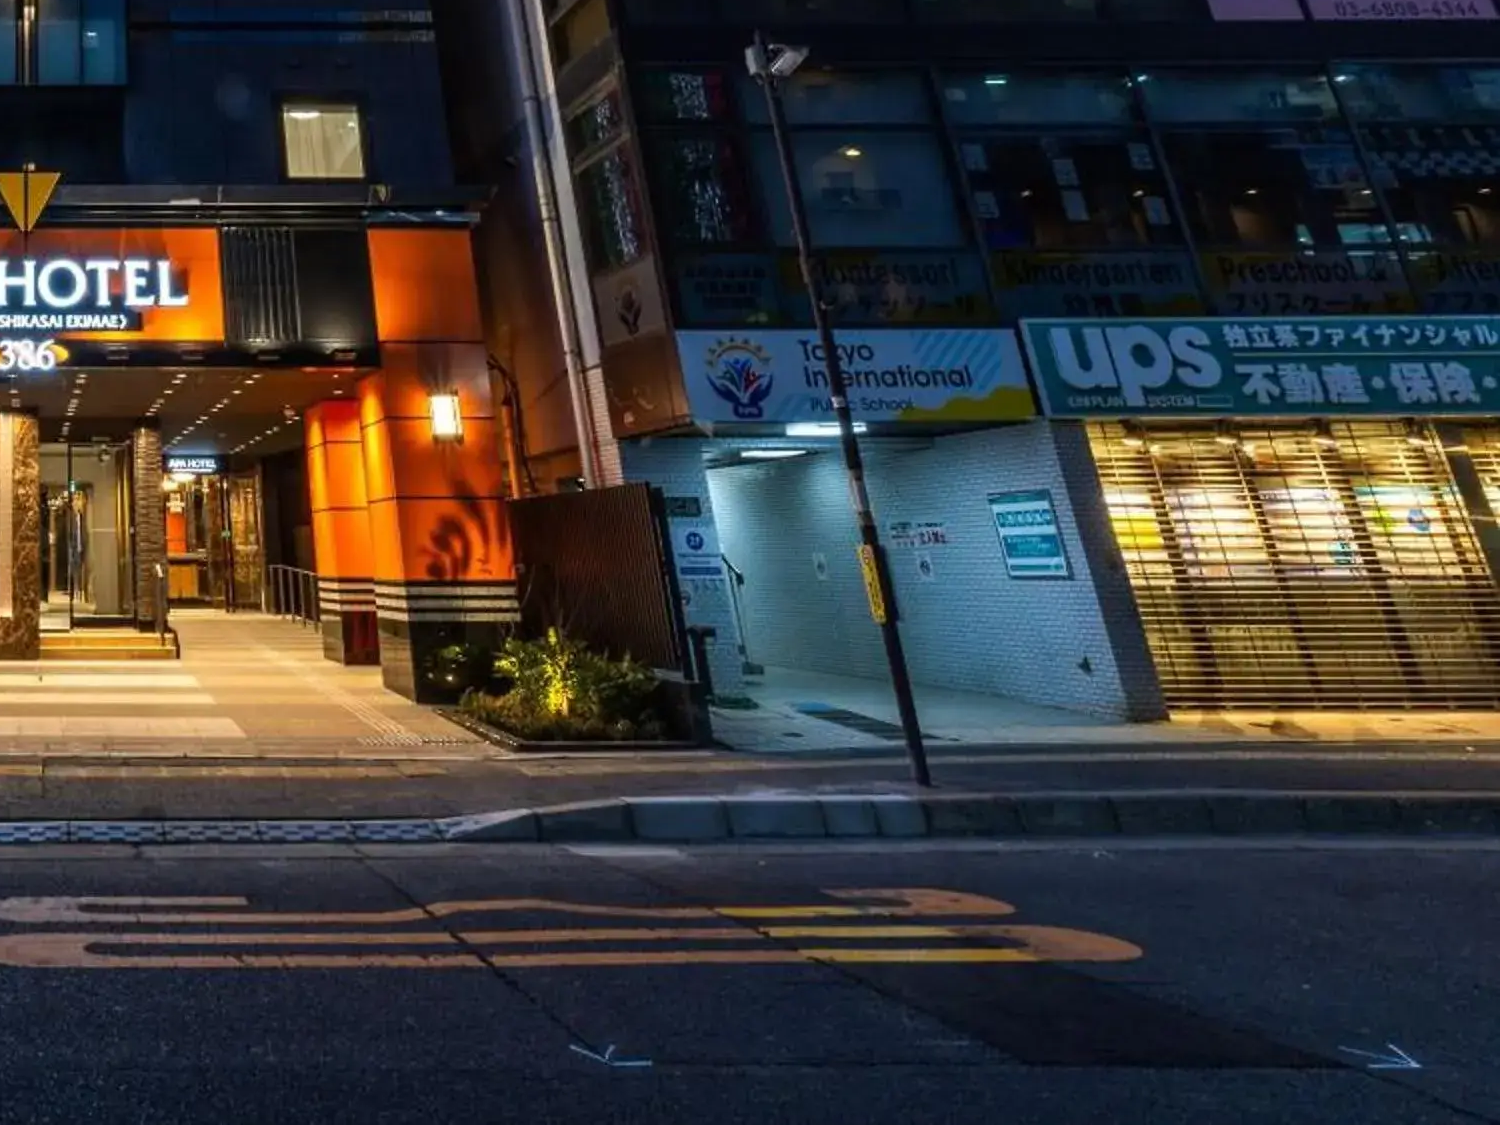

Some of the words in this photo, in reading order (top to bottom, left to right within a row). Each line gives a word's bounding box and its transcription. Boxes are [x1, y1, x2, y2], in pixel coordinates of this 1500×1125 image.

[1222, 324, 1499, 349] 独立系ファイナンシャル
[0, 339, 56, 370] 386
[798, 339, 874, 366] Toyo
[803, 364, 973, 389] Inernational
[1049, 326, 1222, 406] ups
[861, 396, 915, 412] School
[168, 458, 187, 468] APA
[188, 458, 217, 468] HOTEL
